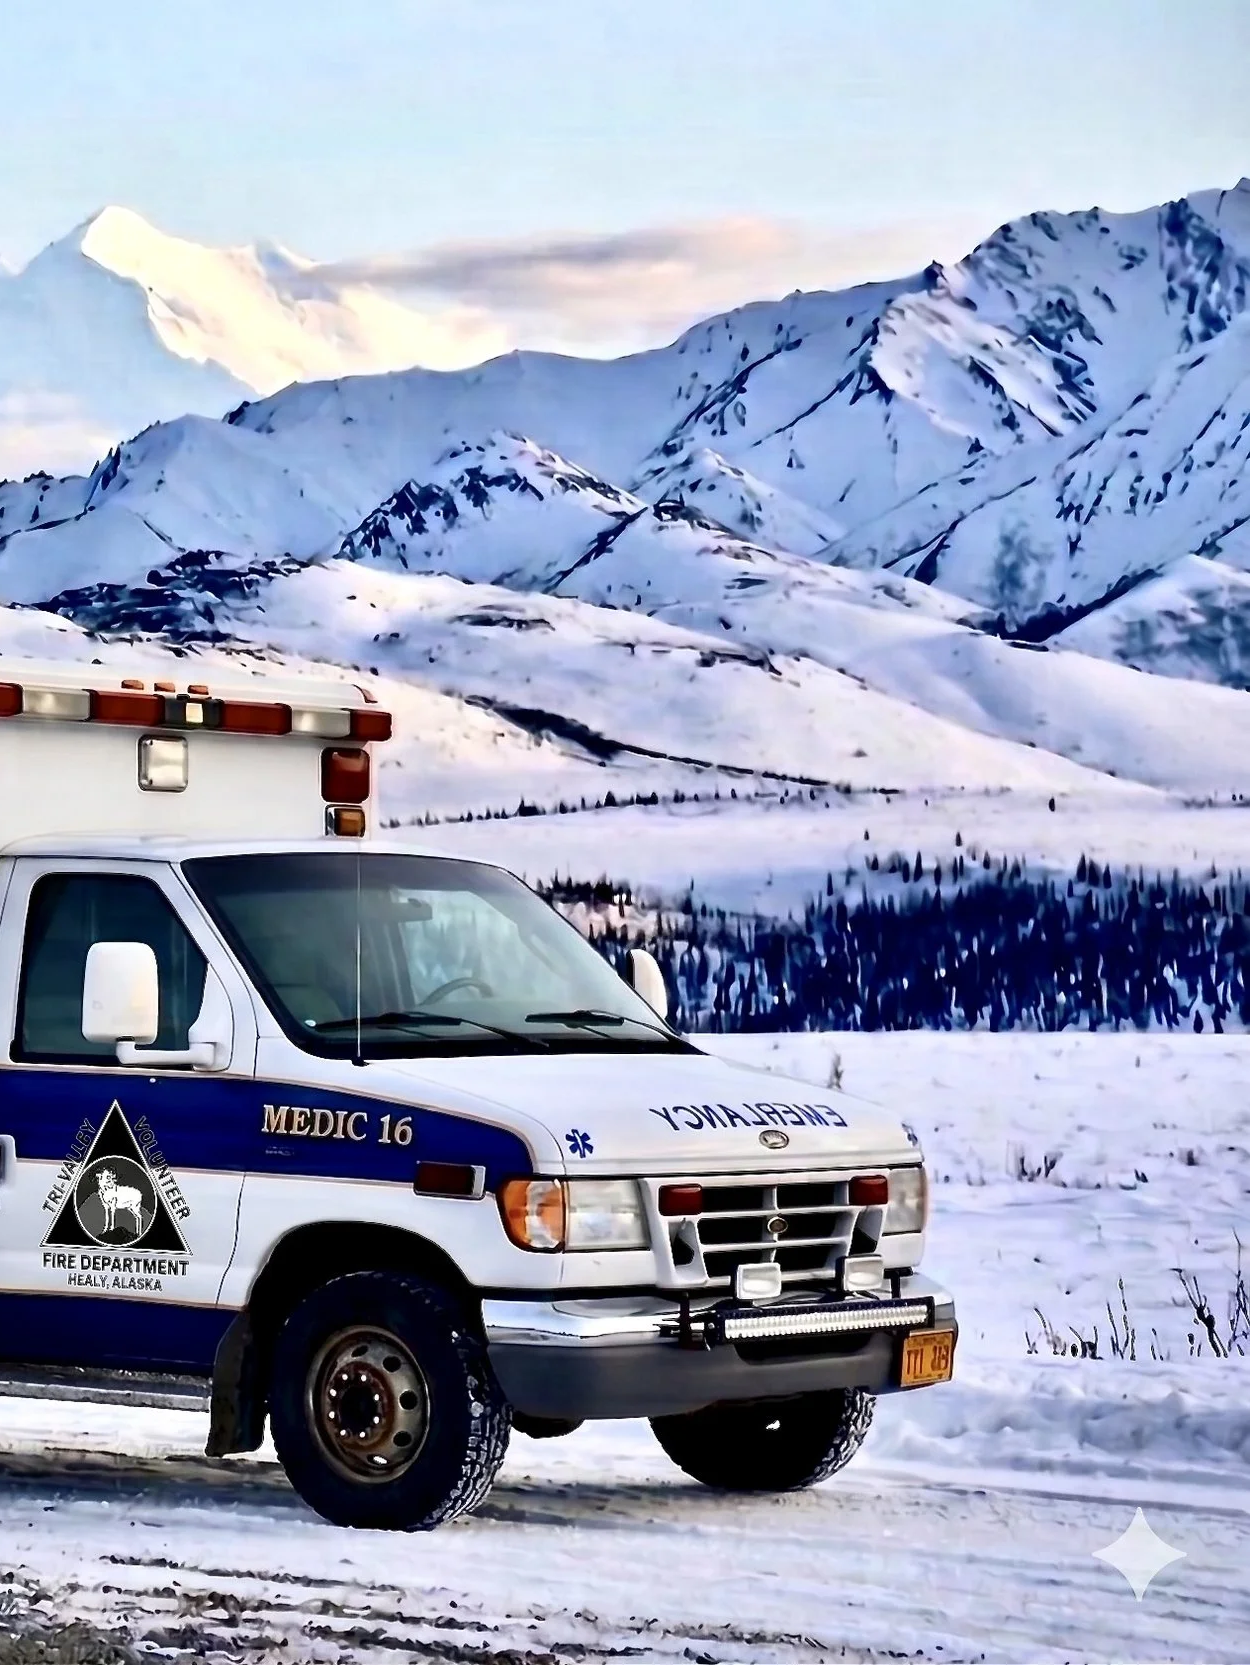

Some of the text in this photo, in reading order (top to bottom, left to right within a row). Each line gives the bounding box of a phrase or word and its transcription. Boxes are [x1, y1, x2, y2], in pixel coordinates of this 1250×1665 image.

[261, 1104, 413, 1146] MEDIC 16
[134, 1115, 191, 1221] VOLUNTEER
[43, 1252, 189, 1276] FIRE DEPARTMENT
[67, 1273, 163, 1291] HEALY, ALASKA
